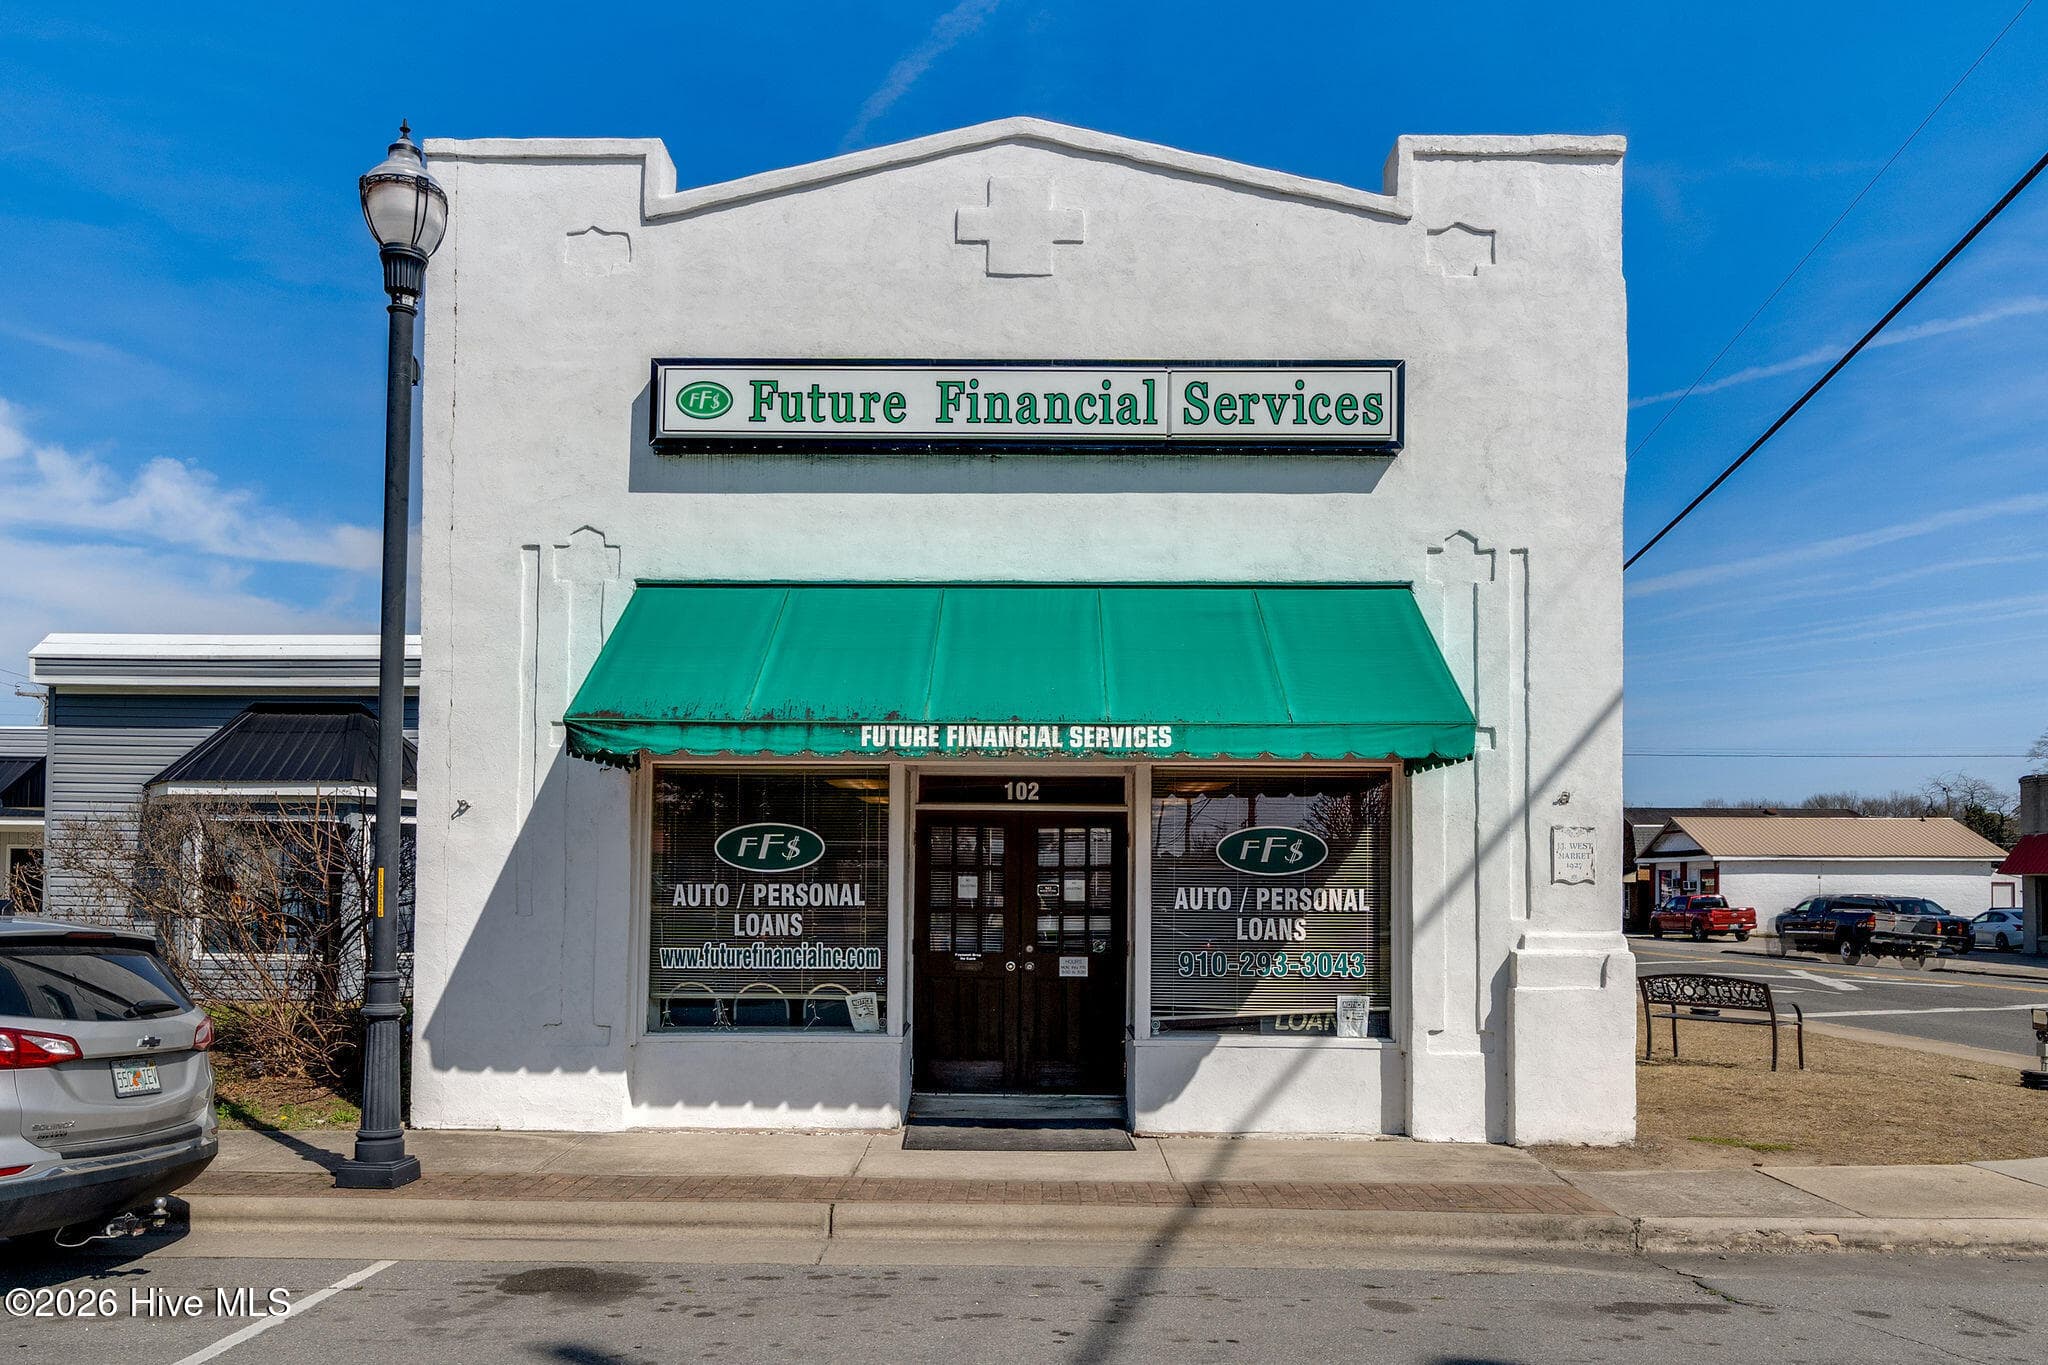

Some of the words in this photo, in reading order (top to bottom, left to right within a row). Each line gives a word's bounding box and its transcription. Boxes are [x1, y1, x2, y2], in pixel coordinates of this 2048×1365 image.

[749, 380, 907, 424] Future
[935, 380, 1159, 426] Financial
[1182, 381, 1384, 427] Services
[861, 725, 939, 747] FUTURE
[946, 725, 1063, 748] FINANCIAL
[1069, 725, 1172, 748] SERVICES
[1004, 781, 1039, 801] 102
[1558, 852, 1591, 860] MARKET
[1569, 842, 1592, 850] WEST
[673, 883, 729, 907] AUTO
[736, 883, 746, 909] /
[753, 883, 866, 907] PERSONAL
[1174, 887, 1232, 910] AUTO
[1239, 887, 1249, 913] /
[1256, 887, 1370, 912] PERSONAL
[733, 913, 803, 937] LOANS
[1236, 917, 1307, 941] LOANS
[1178, 951, 1367, 978] 910-293-3043
